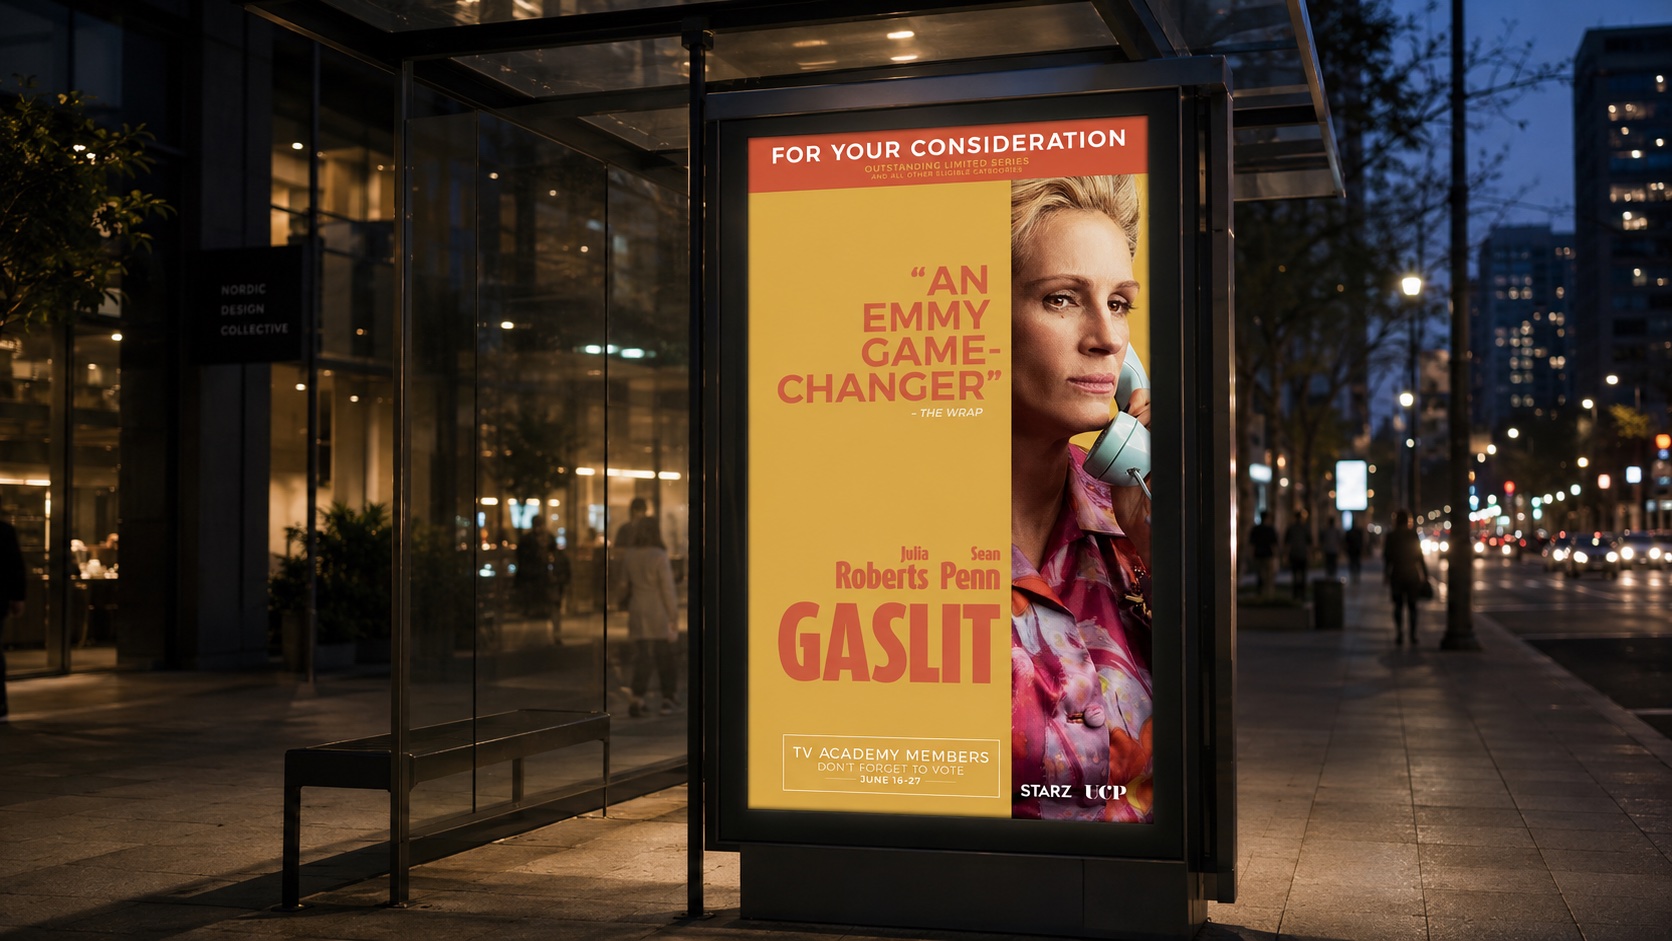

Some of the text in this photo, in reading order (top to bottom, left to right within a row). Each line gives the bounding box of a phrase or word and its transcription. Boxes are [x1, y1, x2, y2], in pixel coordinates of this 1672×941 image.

[771, 128, 1127, 165] FOR YOUR CONSIDERATION
[864, 157, 1030, 173] OUTSTANDING LIMITED SERIES
[911, 264, 989, 297] “AN
[221, 283, 267, 296] NORDIC
[221, 303, 265, 316] DESIGN
[863, 299, 991, 333] EMMY
[220, 322, 289, 336] COLLECTIVE
[861, 335, 1001, 367] GAME-
[777, 370, 1002, 404] CHANGER”
[920, 408, 943, 418] THE
[946, 407, 983, 417] WRAP
[900, 546, 929, 563] Julia
[970, 546, 1001, 561] Sean
[835, 560, 929, 590] Roberts
[940, 561, 1001, 590] Penn
[778, 601, 1001, 684] GASLIT
[793, 746, 990, 764] TV ACADEMY MEMBERS
[859, 763, 908, 774] FORGET
[912, 765, 928, 775] TO
[932, 765, 965, 776] VOTE
[860, 775, 921, 785] JUNE 16-27
[1020, 784, 1073, 798] STARZ
[1084, 784, 1127, 800] UCP
